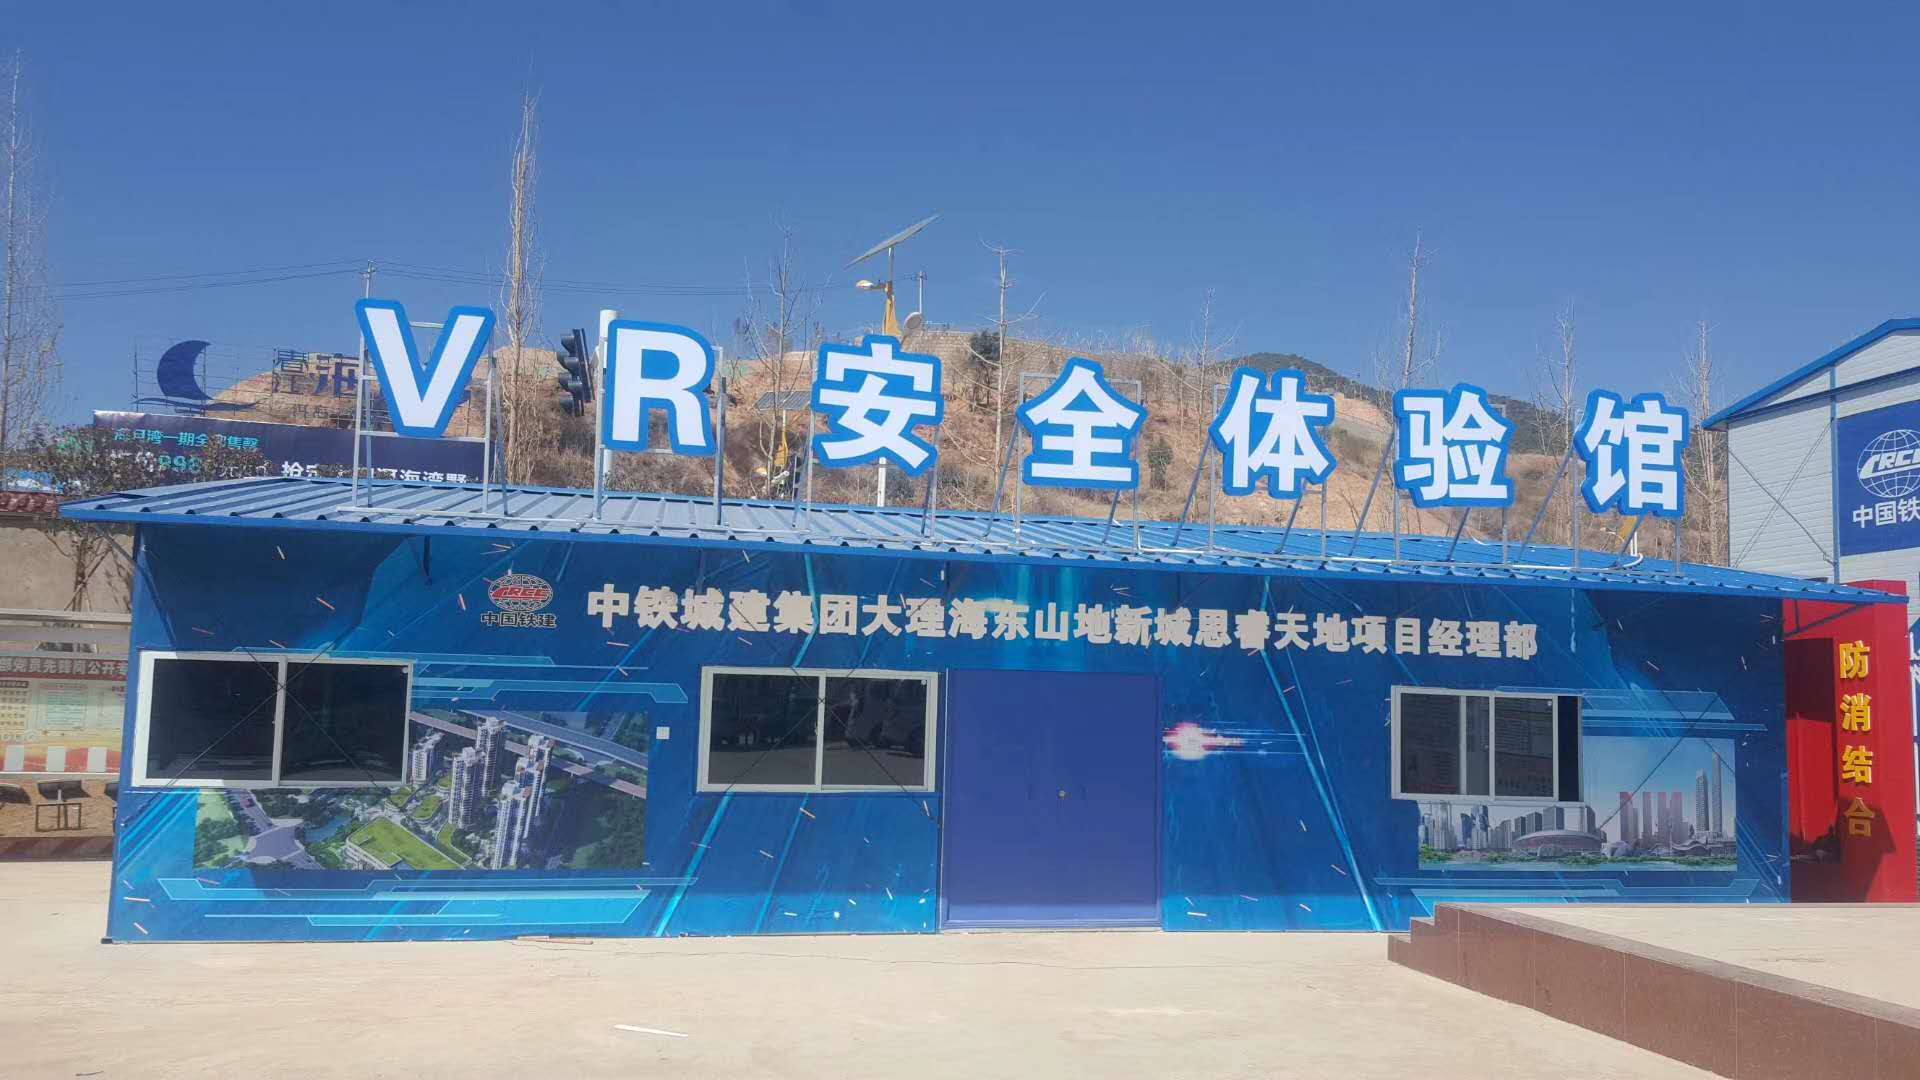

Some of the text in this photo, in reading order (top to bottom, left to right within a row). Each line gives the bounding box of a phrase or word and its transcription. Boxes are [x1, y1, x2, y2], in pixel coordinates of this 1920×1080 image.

[358, 300, 1688, 516] VR安全体验馆
[1852, 496, 1920, 529] 中国铁
[480, 611, 557, 628] 中国铁建
[1839, 640, 1875, 836] 防消结合
